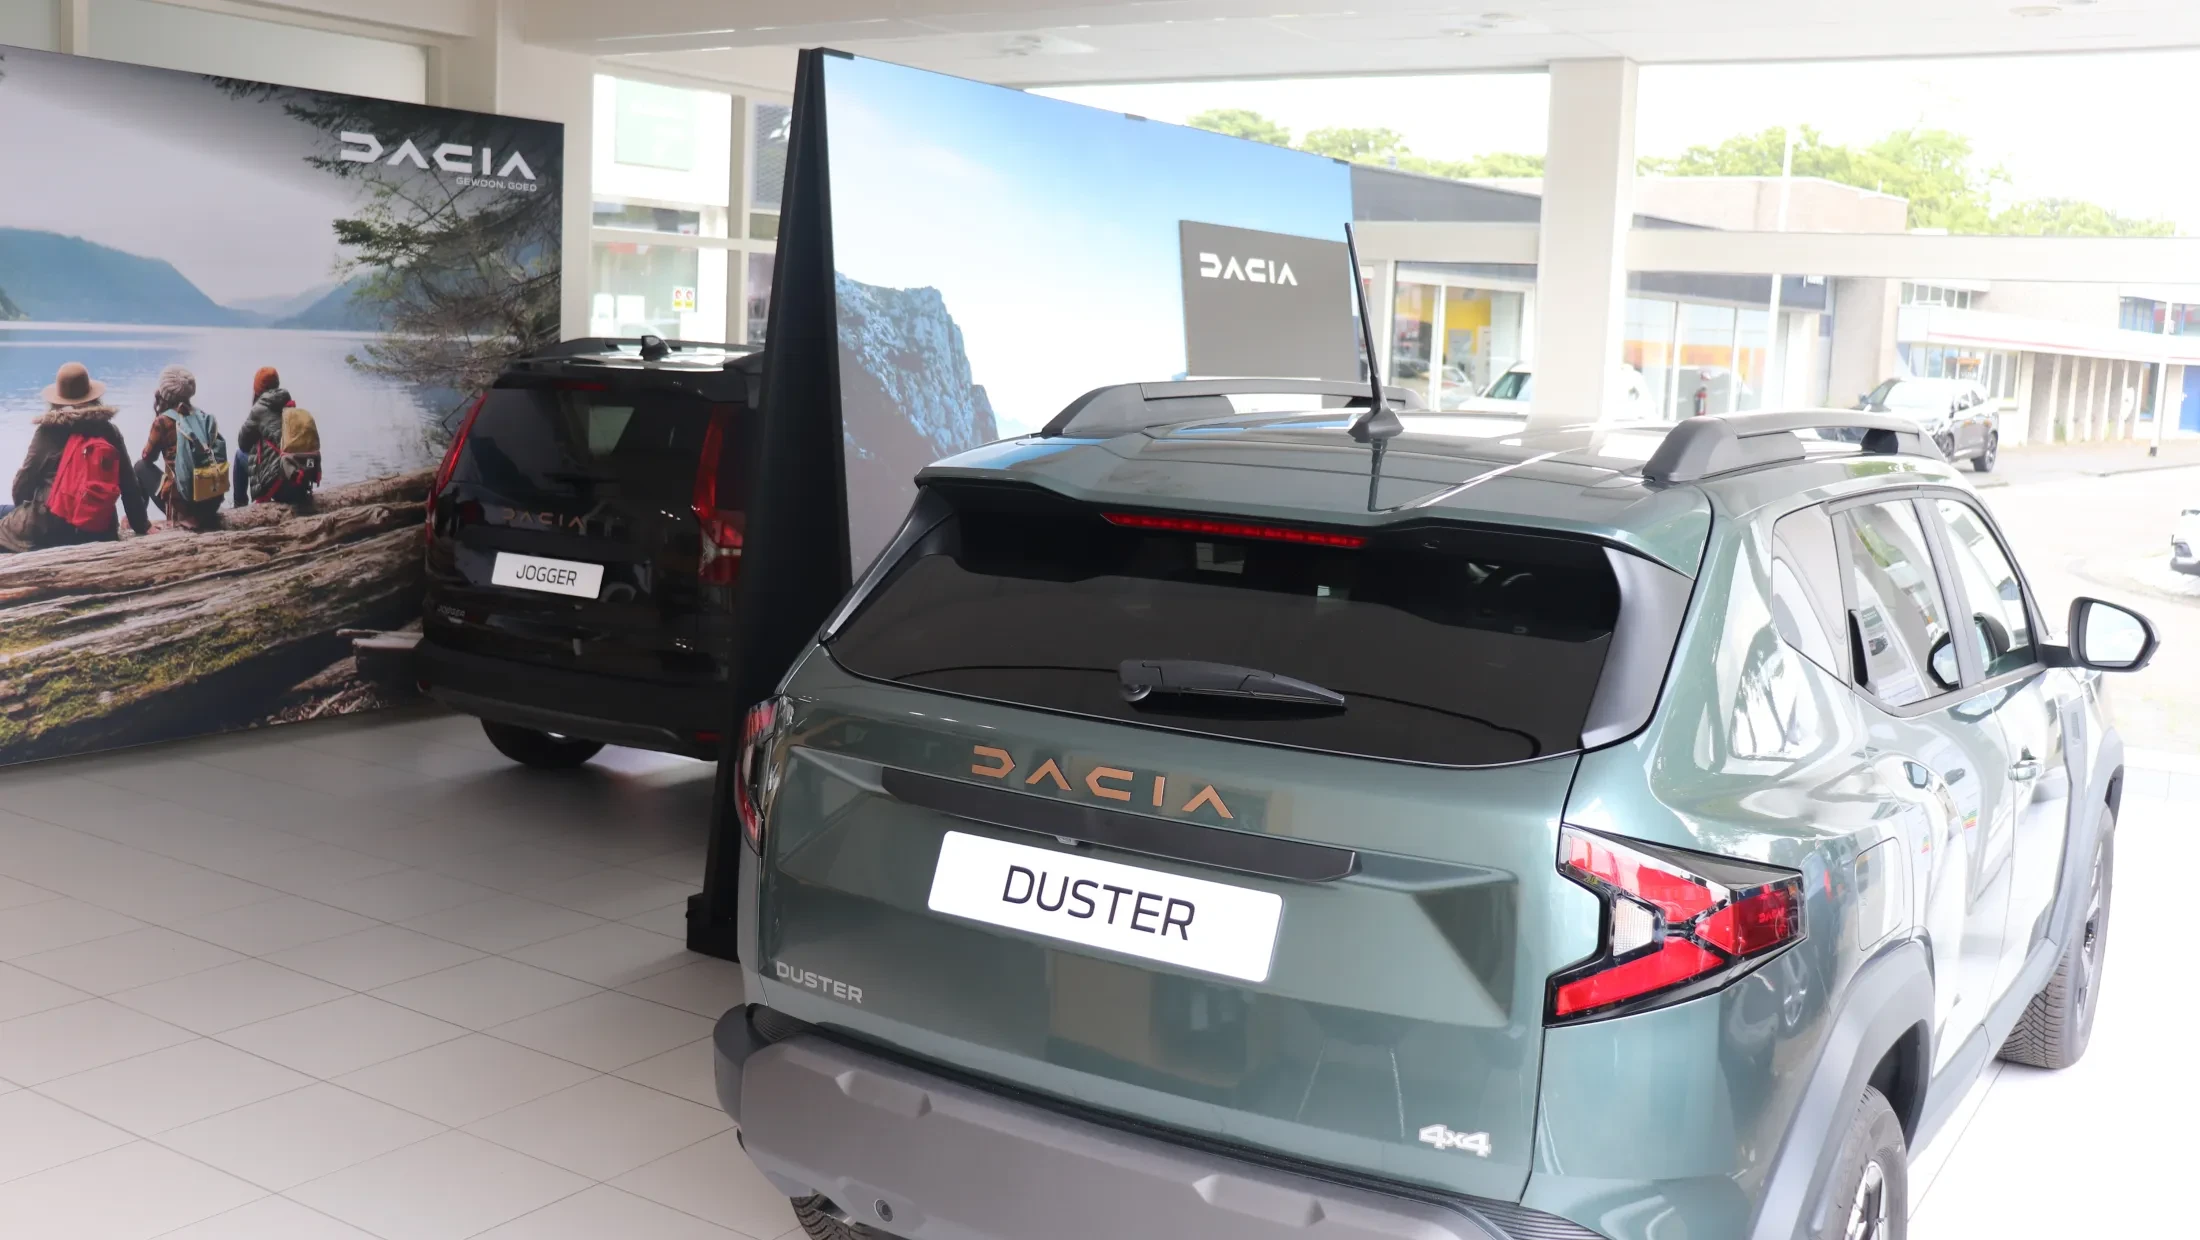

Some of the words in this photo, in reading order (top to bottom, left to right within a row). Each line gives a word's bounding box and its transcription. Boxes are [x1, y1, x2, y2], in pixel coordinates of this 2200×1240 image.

[340, 130, 537, 181] DACIA
[1199, 251, 1299, 286] DACIA
[502, 507, 586, 529] DACIA
[515, 564, 578, 587] JOGGER
[970, 744, 1234, 820] DACIA
[1001, 863, 1196, 942] DUSTER
[776, 959, 864, 1005] DUSTER
[1418, 1123, 1493, 1159] 4x4
